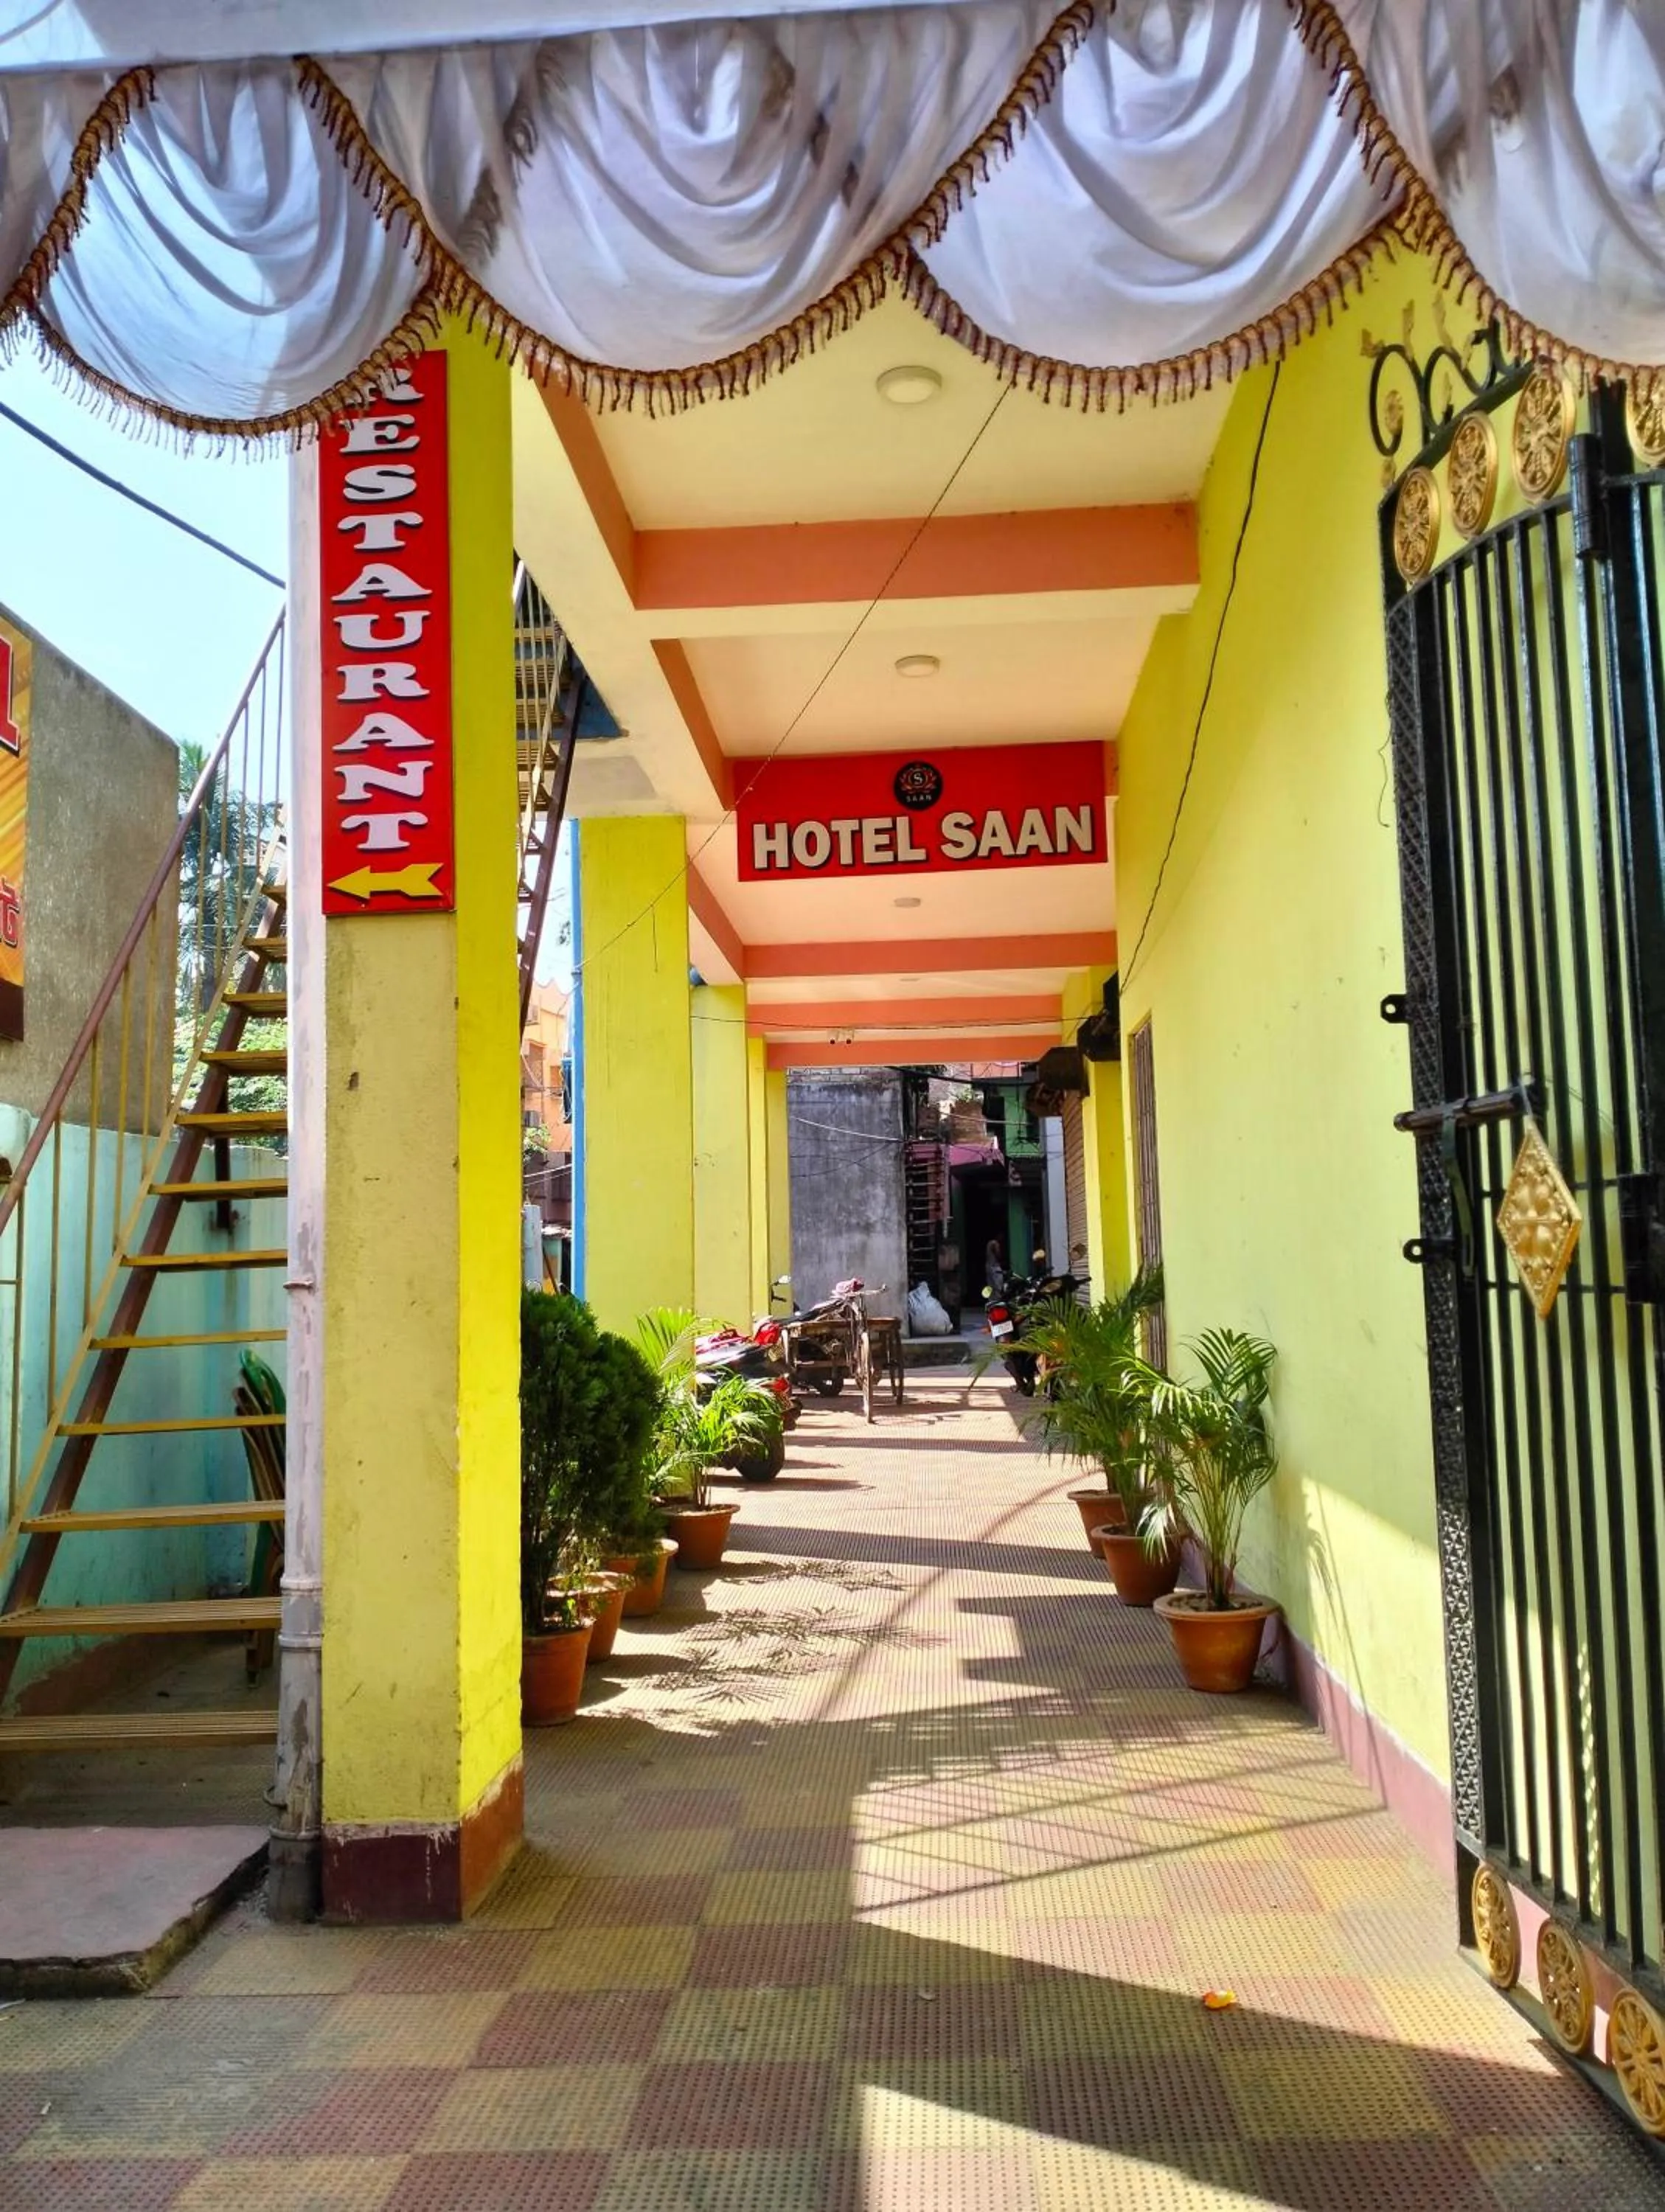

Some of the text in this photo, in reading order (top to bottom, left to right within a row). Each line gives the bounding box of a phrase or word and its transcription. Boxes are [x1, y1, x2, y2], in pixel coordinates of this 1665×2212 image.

[906, 794, 932, 803] SAAN
[752, 805, 1093, 869] HOTEL SAAN
